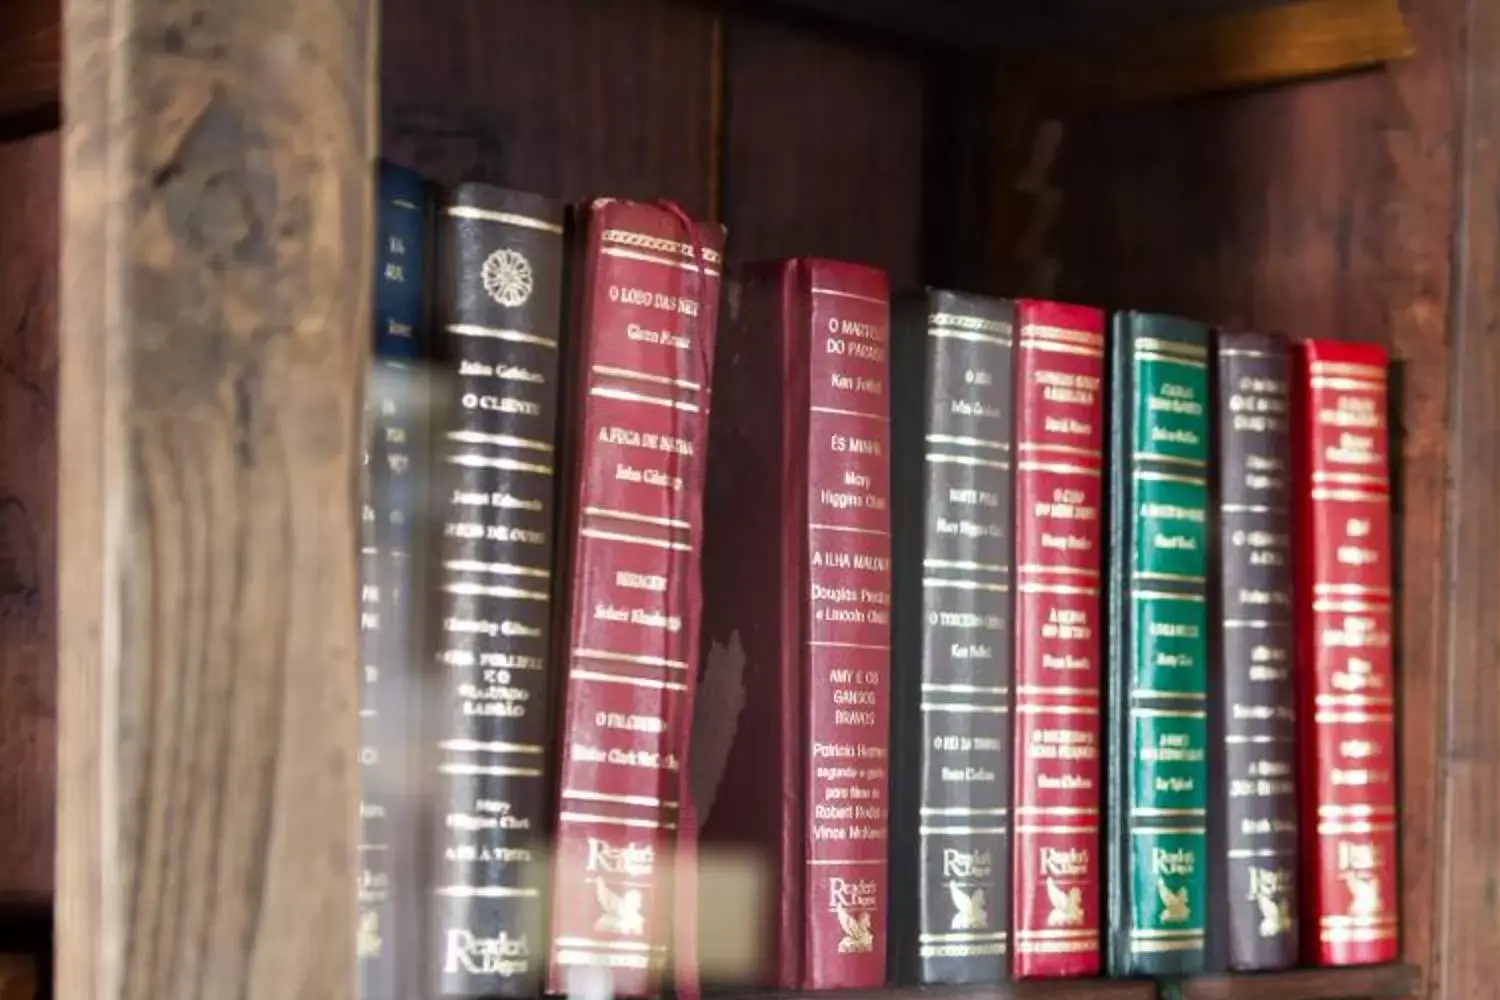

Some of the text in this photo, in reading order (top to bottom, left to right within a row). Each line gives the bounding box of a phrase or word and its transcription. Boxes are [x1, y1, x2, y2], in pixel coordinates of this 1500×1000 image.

[609, 285, 619, 300] O
[828, 317, 839, 333] O
[826, 339, 844, 354] DO
[831, 373, 853, 390] Ken
[844, 472, 870, 490] Mary
[821, 489, 863, 508] Higgins
[812, 551, 822, 566] A
[825, 551, 850, 568] ILHA
[811, 583, 857, 602] Douglas
[825, 607, 865, 624] Lincoln
[829, 668, 852, 684] AMY
[834, 689, 876, 705] GANSOS
[835, 709, 875, 728] BRAVOS
[815, 804, 853, 820] Robert
[812, 825, 846, 841] Vince
